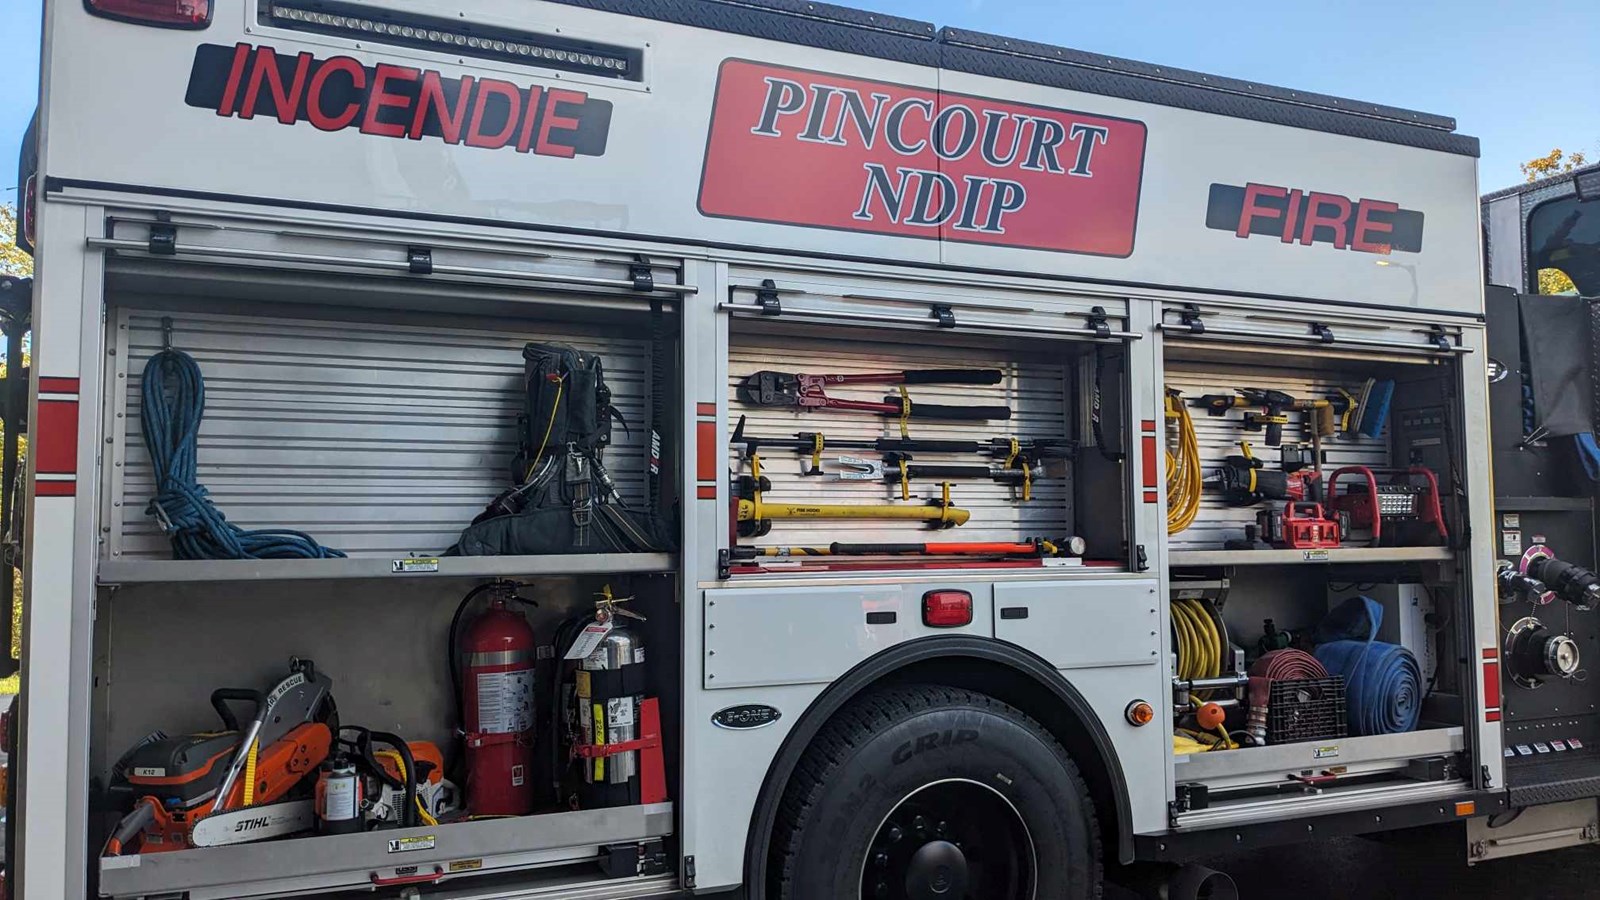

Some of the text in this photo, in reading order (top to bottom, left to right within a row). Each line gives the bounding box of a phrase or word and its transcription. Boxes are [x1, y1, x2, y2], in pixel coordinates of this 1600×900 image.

[216, 42, 588, 158] INCENDIE
[751, 77, 1108, 177] PINCOURT
[853, 163, 1026, 233] NDIP
[1236, 182, 1399, 255] FIRE
[278, 675, 302, 694] RESCUE
[726, 708, 771, 723] E-ONE
[891, 729, 979, 766] GRIP
[235, 816, 270, 832] STIHL
